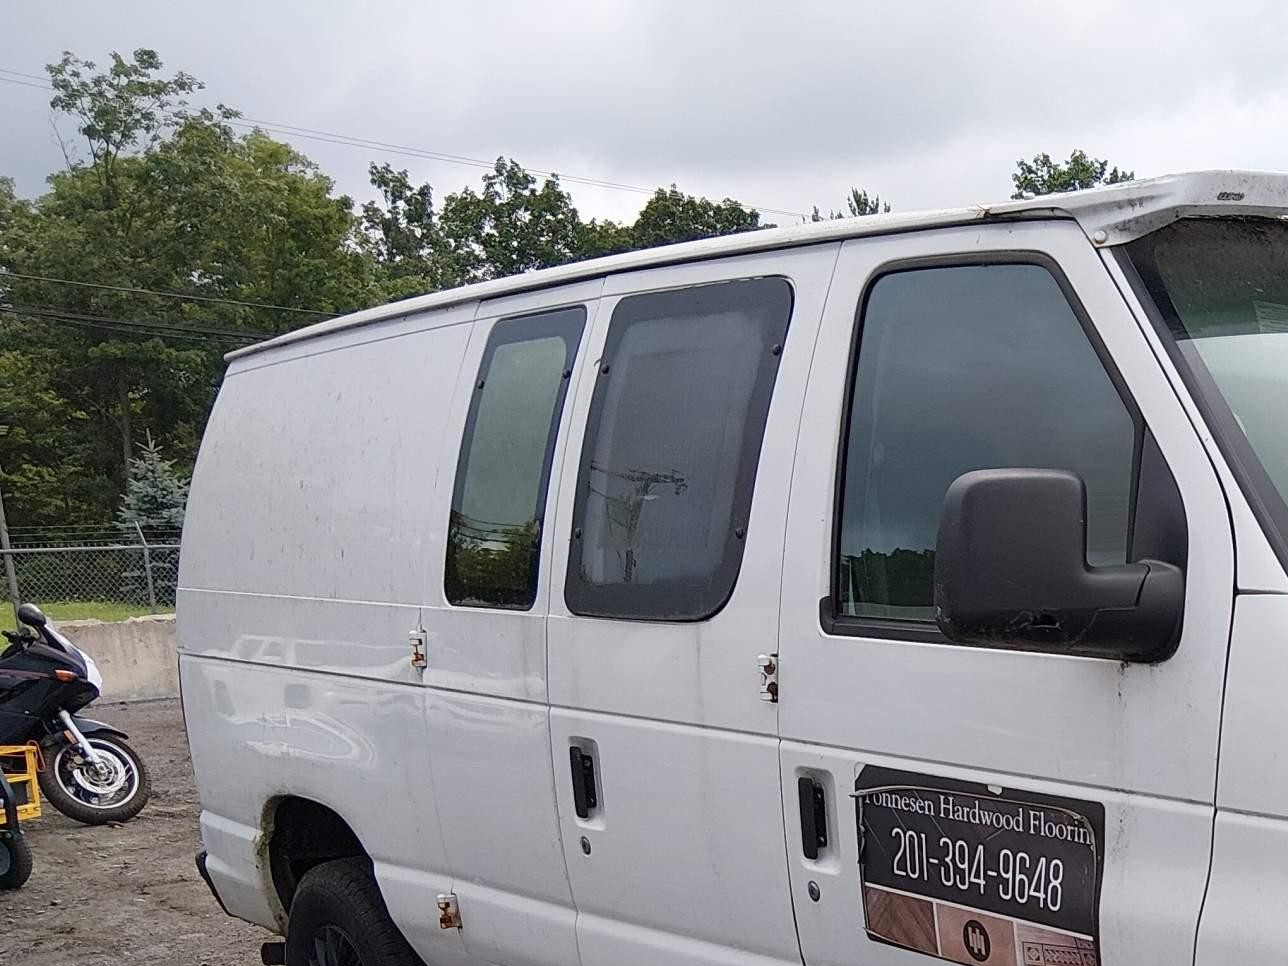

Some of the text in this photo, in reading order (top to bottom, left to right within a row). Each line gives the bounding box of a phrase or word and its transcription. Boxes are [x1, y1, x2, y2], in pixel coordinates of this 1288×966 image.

[938, 795, 1024, 832] Hardwood
[1028, 810, 1092, 845] Floorin
[891, 827, 1064, 912] 201-394-9648
